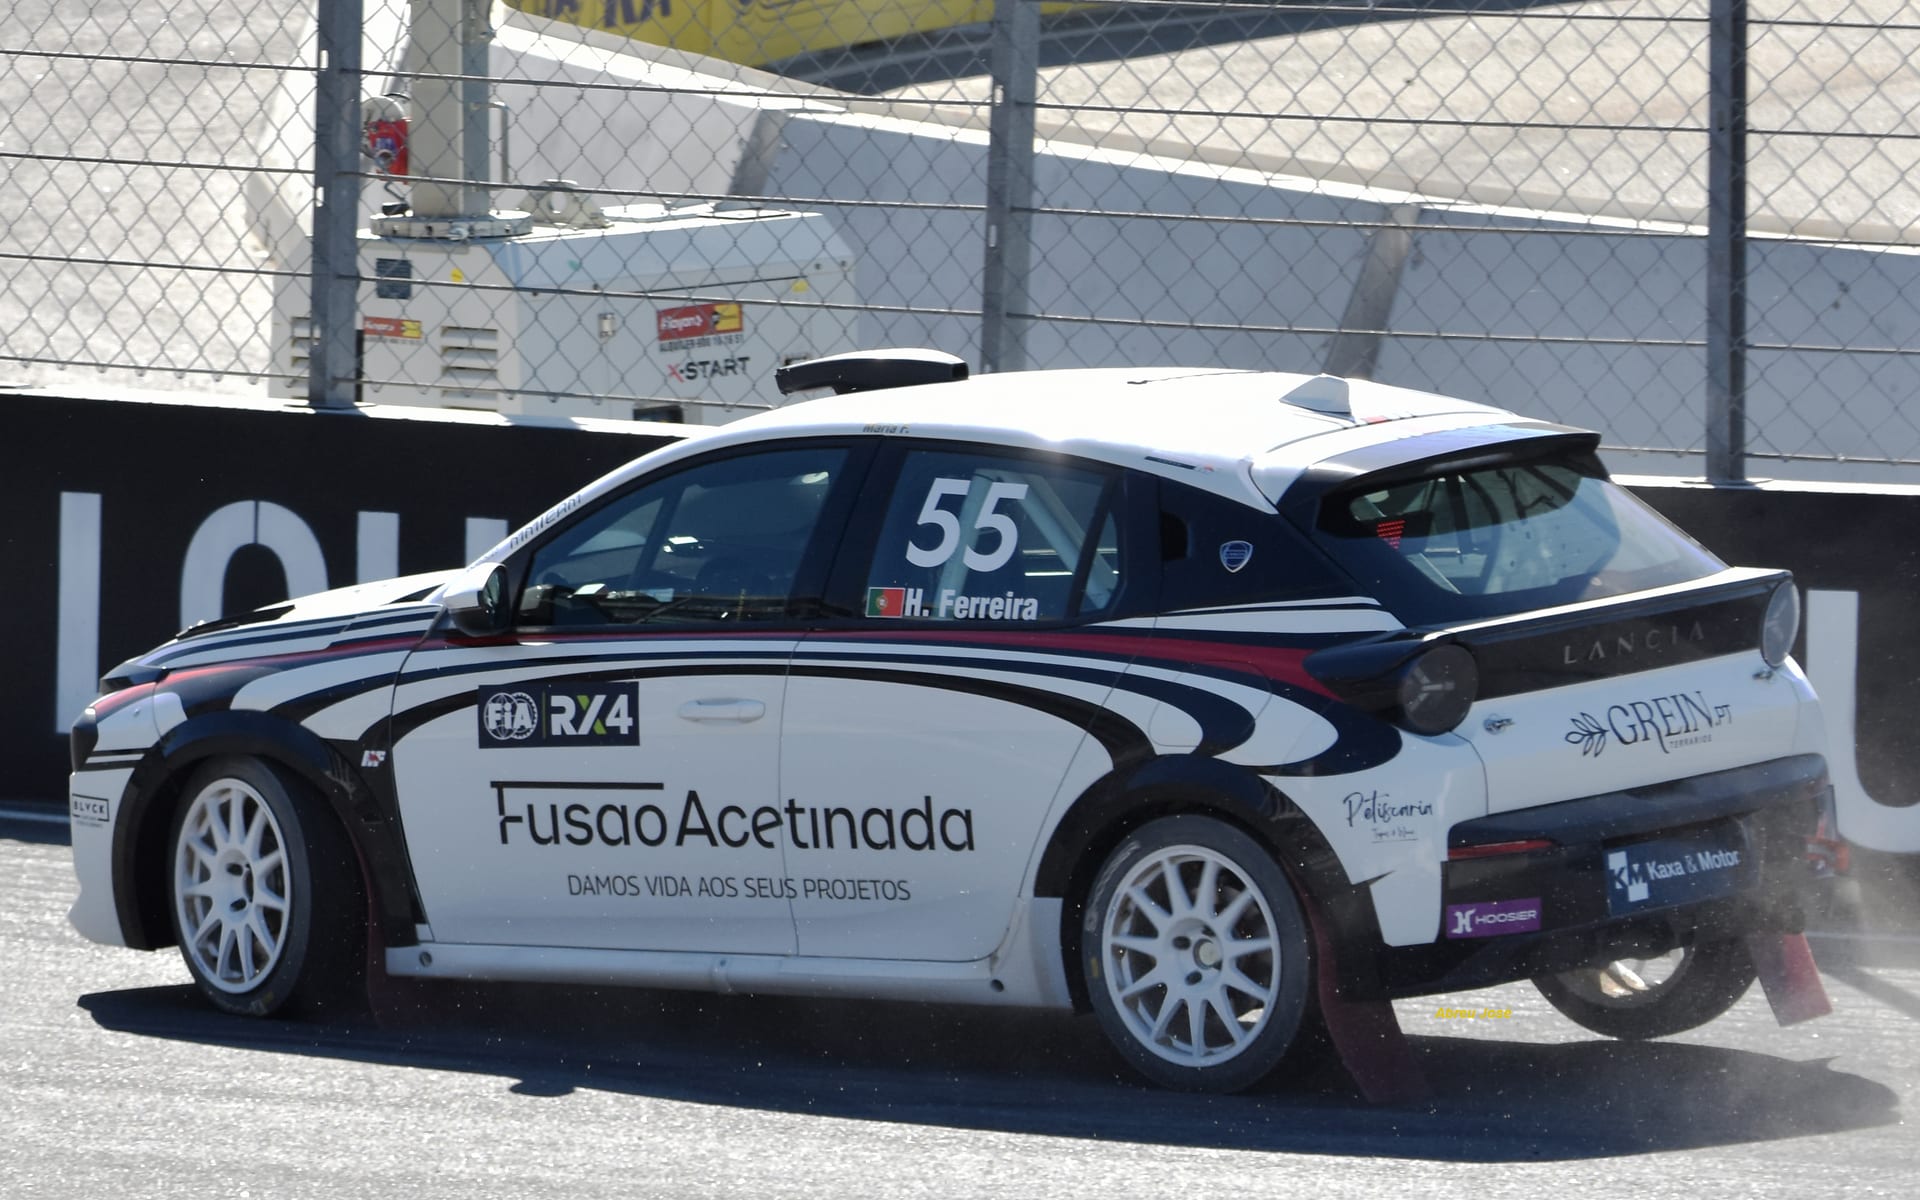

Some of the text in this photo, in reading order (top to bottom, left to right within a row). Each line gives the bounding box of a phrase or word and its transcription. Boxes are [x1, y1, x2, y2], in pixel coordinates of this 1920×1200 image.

[905, 477, 1029, 572] 55
[904, 588, 1039, 620] H. Ferreira
[1564, 621, 1705, 665] LANCIA
[550, 694, 634, 736] RX4
[1646, 861, 1686, 880] Kaxa
[1685, 855, 1699, 873] &
[1697, 849, 1740, 871] Motor
[567, 875, 912, 901] DAMOS VIDA AOS SEUS PROJETOS
[1475, 910, 1537, 925] HOOSIER
